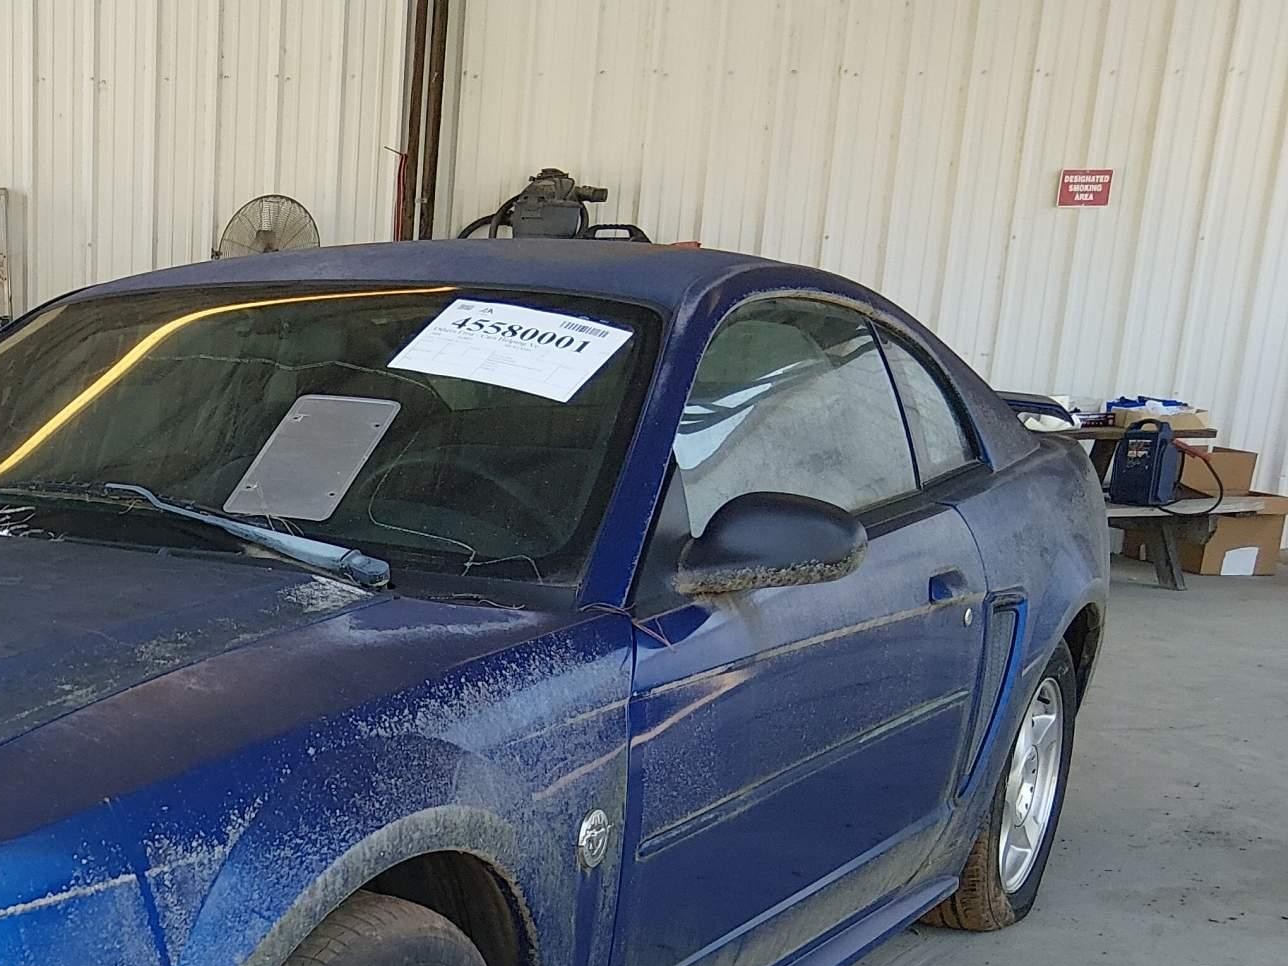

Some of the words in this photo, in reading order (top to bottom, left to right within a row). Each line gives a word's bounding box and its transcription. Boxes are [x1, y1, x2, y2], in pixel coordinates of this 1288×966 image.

[1064, 175, 1110, 183] DESIGNATED
[1068, 184, 1102, 192] SMOKING
[1074, 193, 1094, 201] AREA
[451, 316, 591, 353] 45580001
